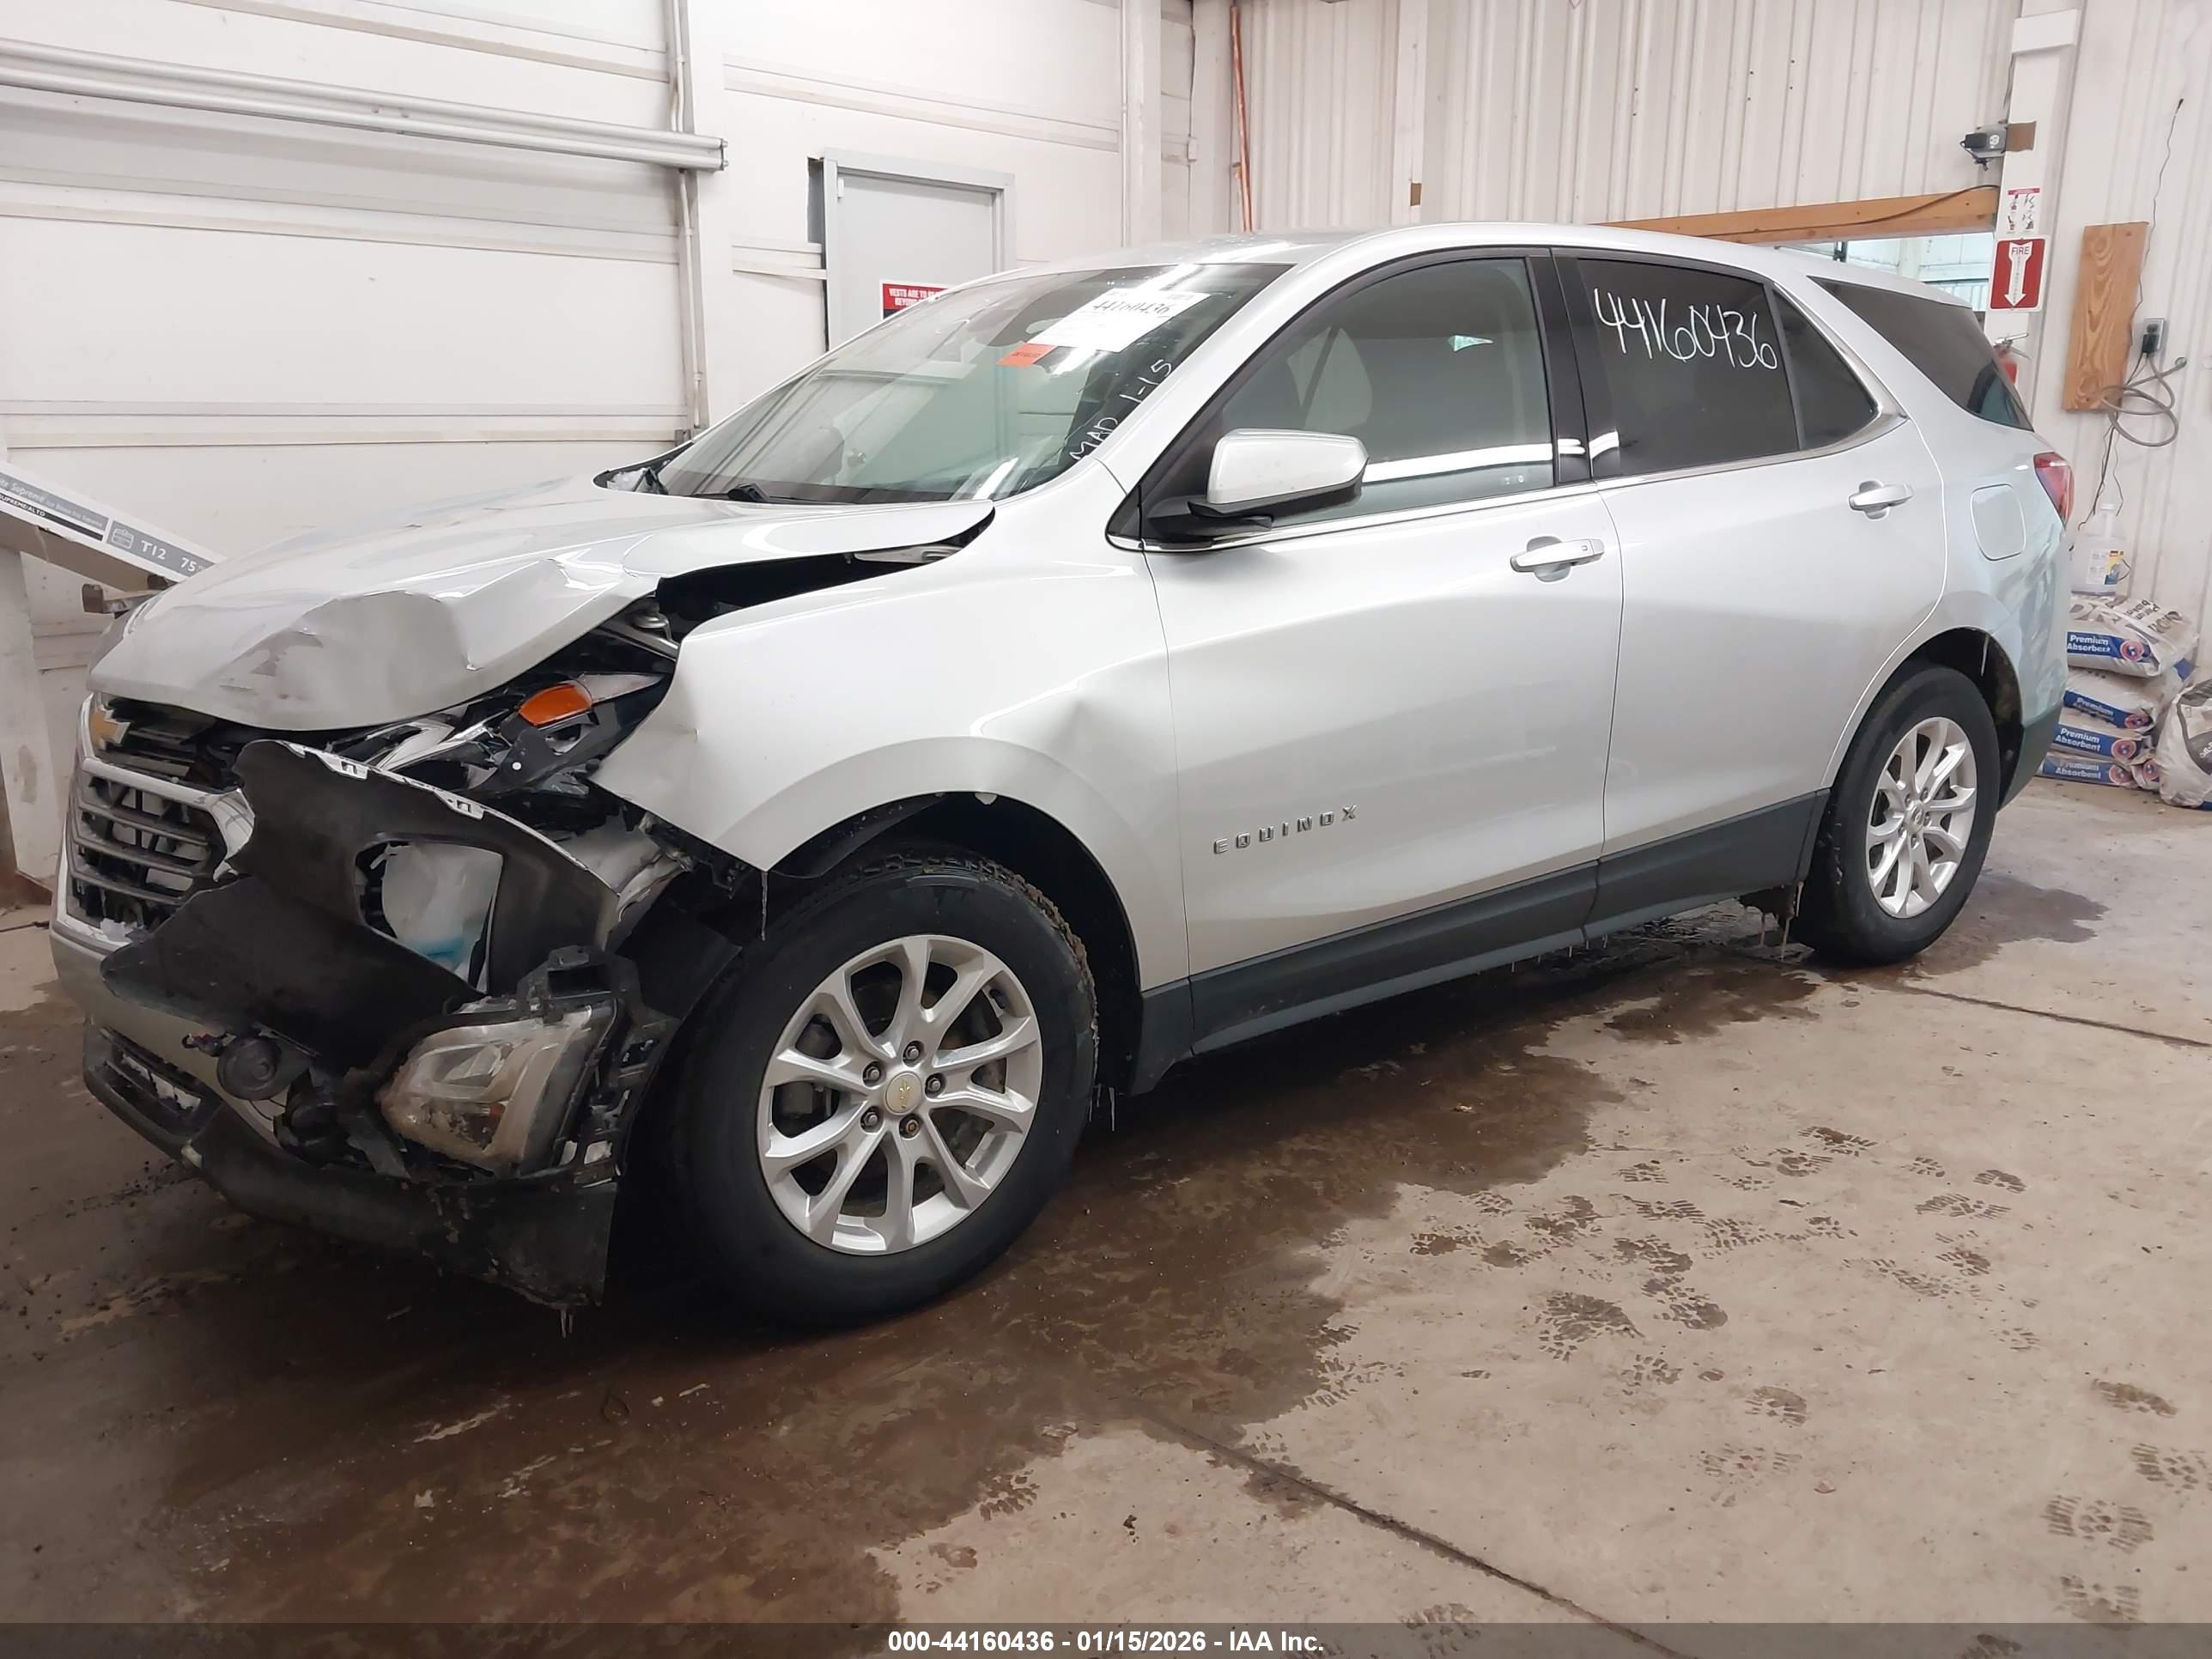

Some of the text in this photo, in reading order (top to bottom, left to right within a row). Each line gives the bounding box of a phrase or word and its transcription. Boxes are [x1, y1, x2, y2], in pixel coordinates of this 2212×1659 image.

[2011, 246, 2030, 255] FIRE
[1594, 288, 1778, 369] 44160436
[1069, 416, 1118, 460] MAD
[10, 483, 46, 501] Supreme
[141, 539, 198, 572] T12 75
[2069, 634, 2109, 646] Premium
[2076, 696, 2114, 716] Premium
[2055, 734, 2101, 751] Absorbent
[2061, 727, 2100, 744] Premium
[2055, 767, 2101, 779] Absorbent
[1213, 804, 1358, 854] EQUINOX
